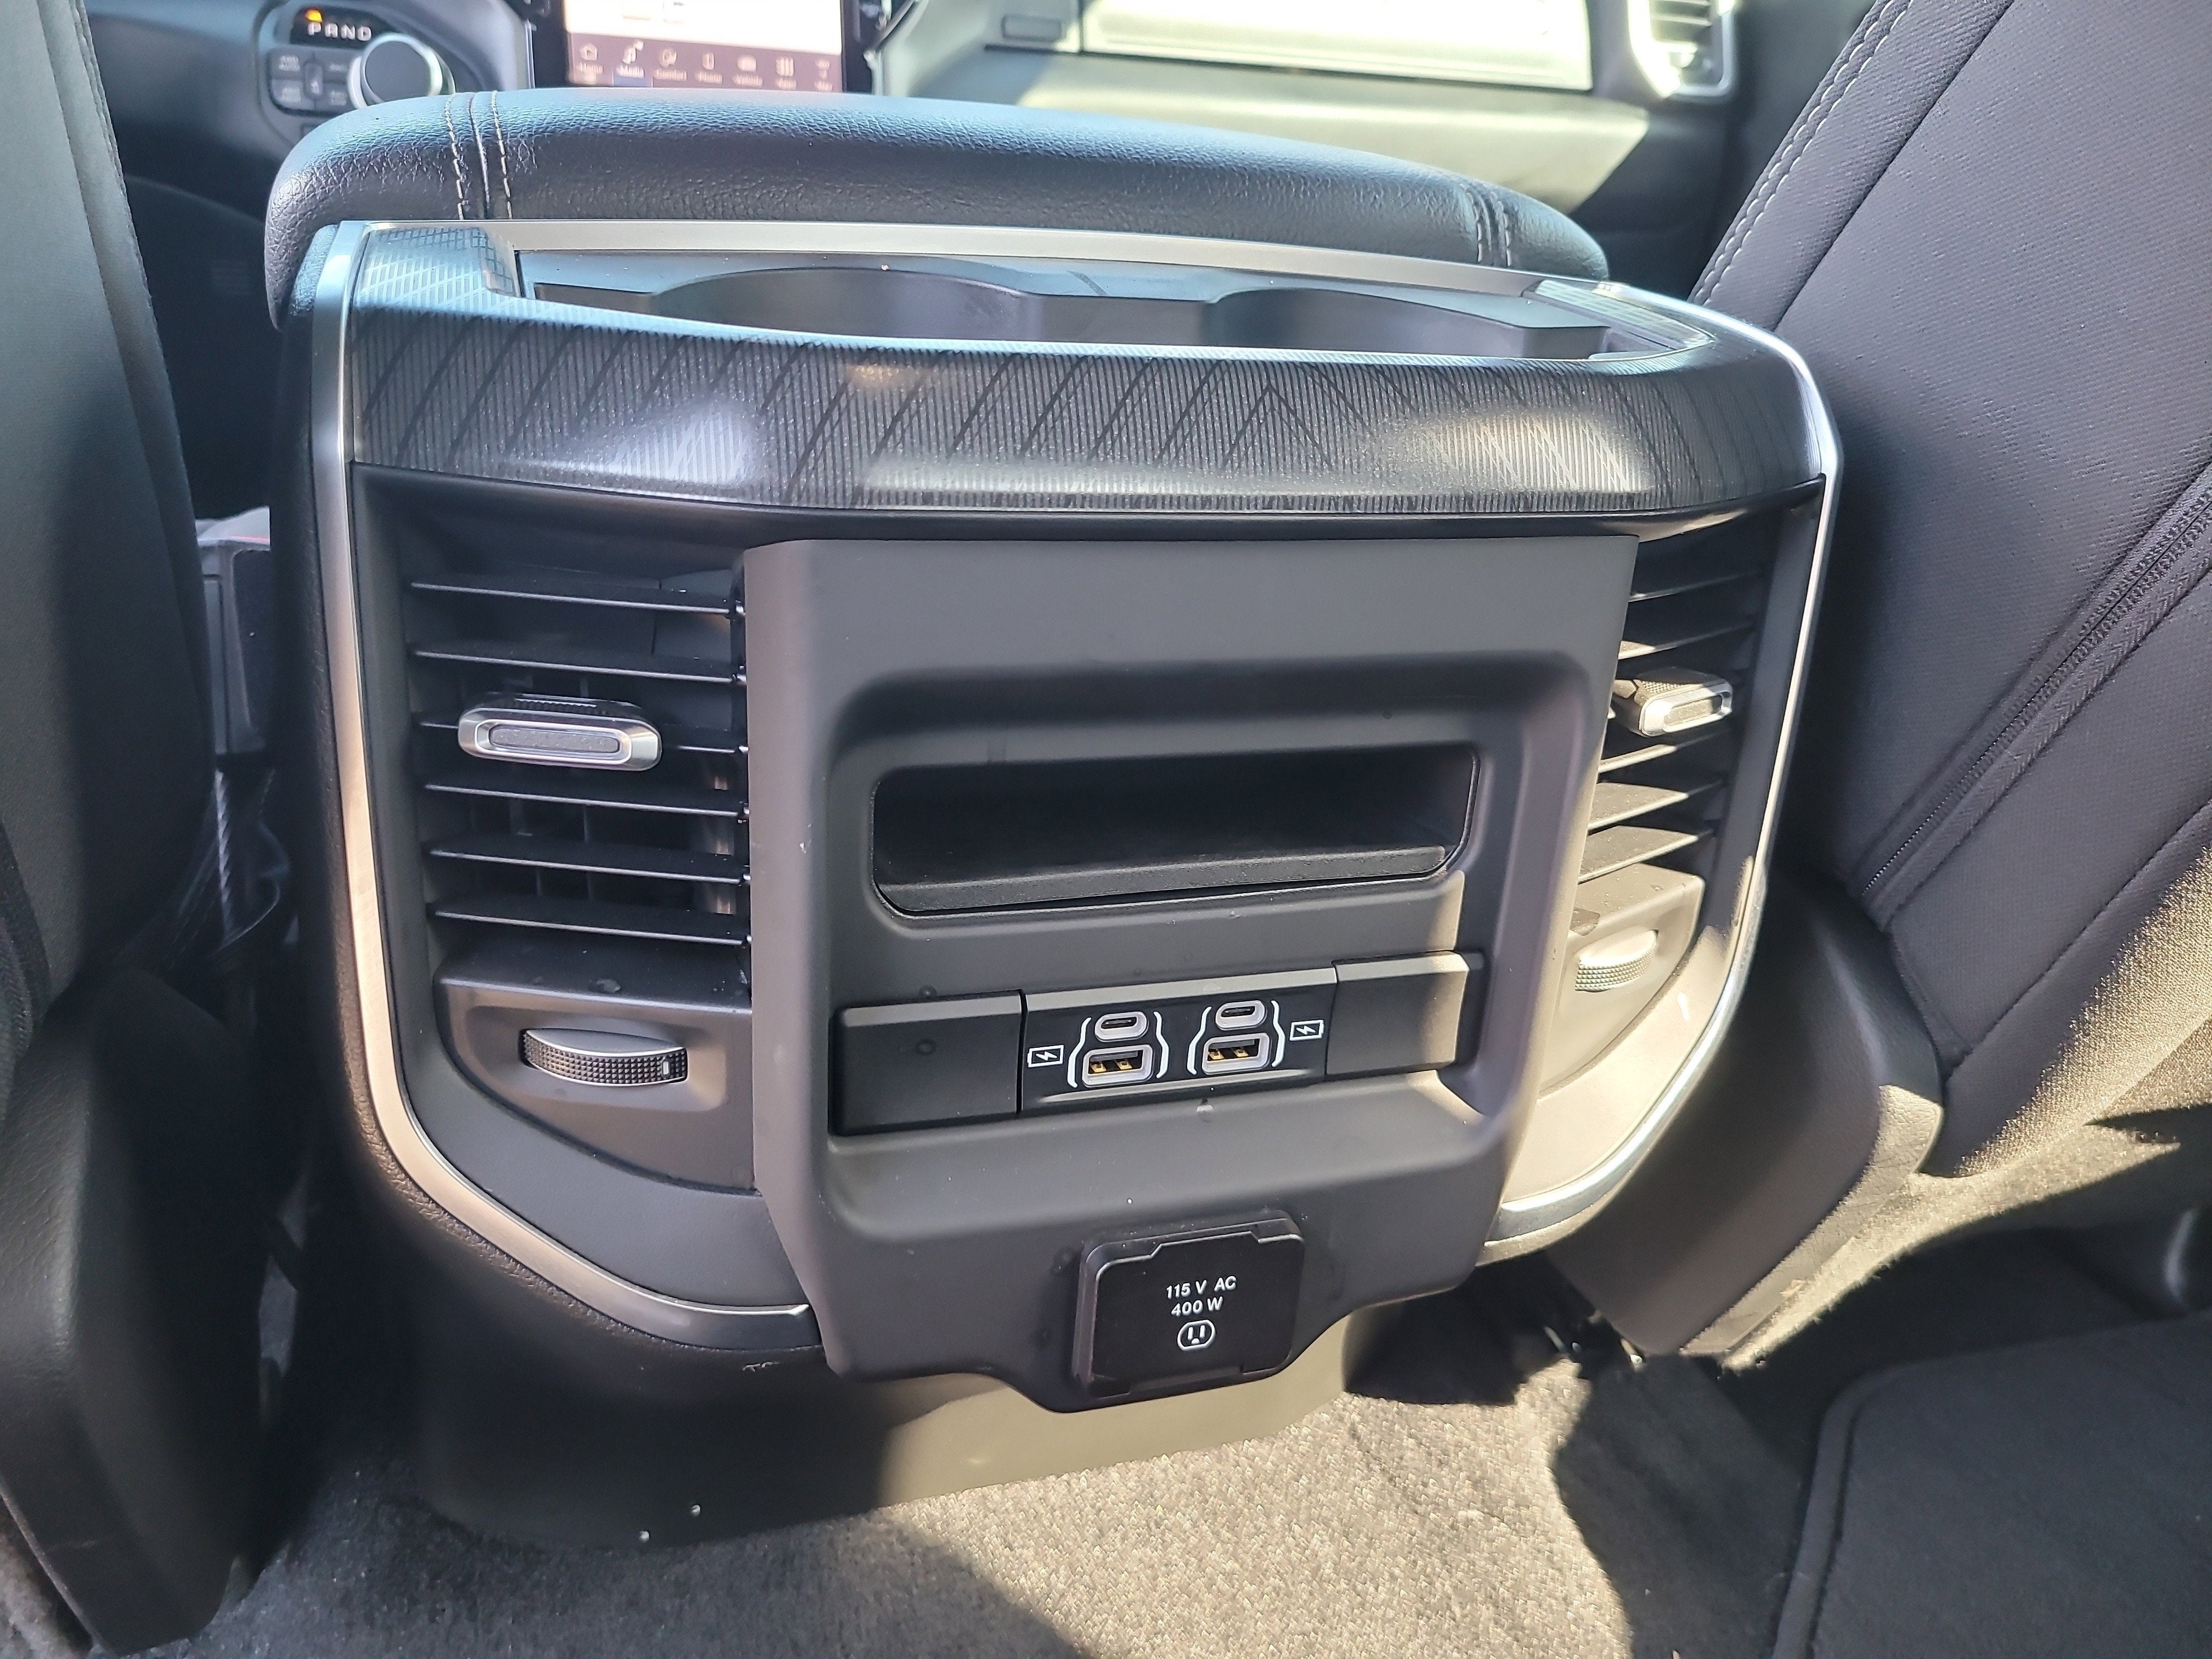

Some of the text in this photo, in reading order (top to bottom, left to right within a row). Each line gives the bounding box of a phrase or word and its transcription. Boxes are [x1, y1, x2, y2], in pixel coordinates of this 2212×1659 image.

[1166, 1276, 1237, 1300] 115 V AC
[1171, 1296, 1223, 1317] 400 W
